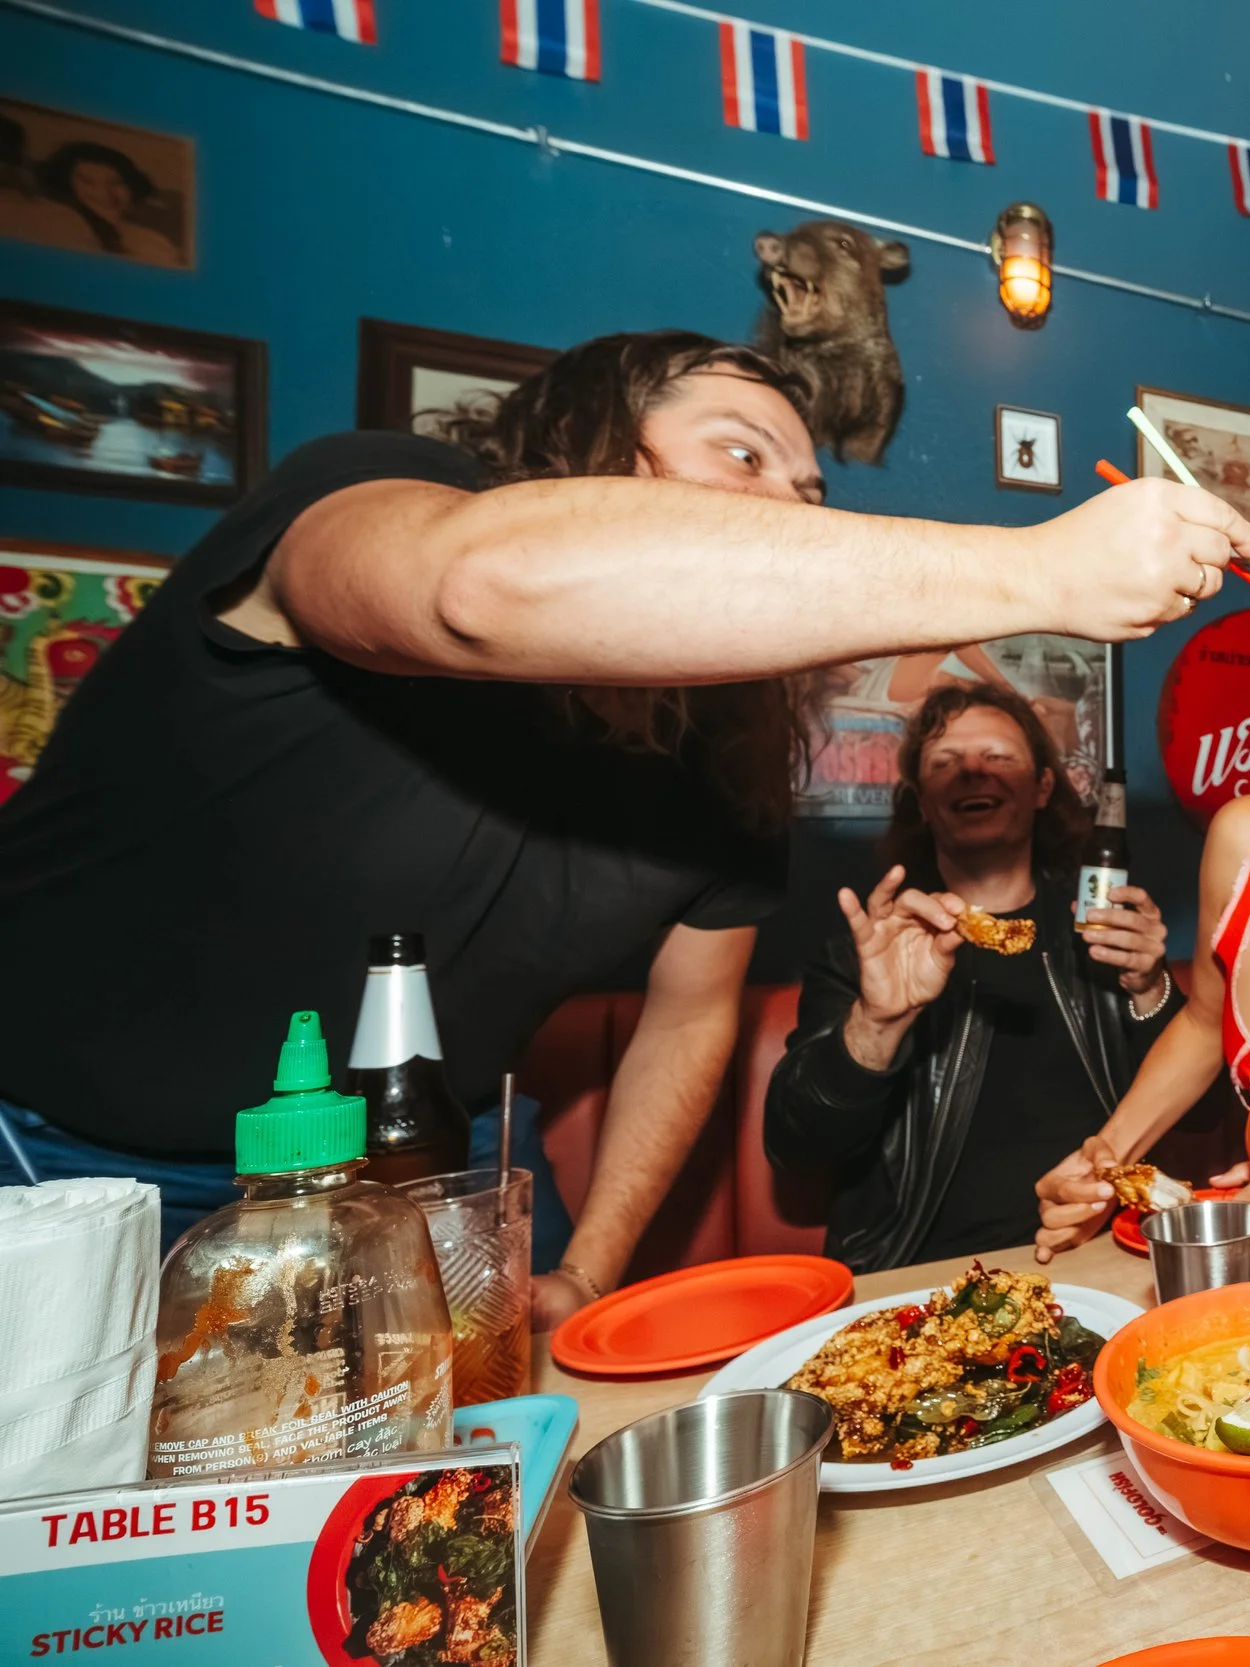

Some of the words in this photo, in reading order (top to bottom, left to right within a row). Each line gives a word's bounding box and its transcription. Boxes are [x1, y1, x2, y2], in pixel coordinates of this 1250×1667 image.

[151, 1440, 186, 1452] EMOVE
[188, 1438, 209, 1450] CAP
[211, 1434, 235, 1446] AND
[239, 1425, 277, 1442] BREAK
[281, 1418, 307, 1431] FOIL
[311, 1409, 338, 1424] SEAL
[341, 1398, 368, 1415] WITH
[371, 1381, 409, 1404] CAUTION
[178, 1447, 234, 1463] REMOVING
[275, 1431, 304, 1446] FACE
[308, 1424, 329, 1437] THE
[332, 1404, 381, 1429] PRODUCT
[383, 1393, 408, 1410] AWAY
[173, 1464, 202, 1477] FROM
[272, 1445, 297, 1458] AND
[358, 1413, 388, 1432] ITEMS
[347, 1436, 372, 1454] cay
[357, 1447, 379, 1459] ác
[41, 1502, 177, 1548] TABLE
[191, 1494, 270, 1532] B15
[88, 1603, 125, 1623] ร้าน
[132, 1592, 225, 1618] ข้าวเหนียว
[30, 1619, 149, 1658] STICKY
[154, 1610, 225, 1641] RICE
